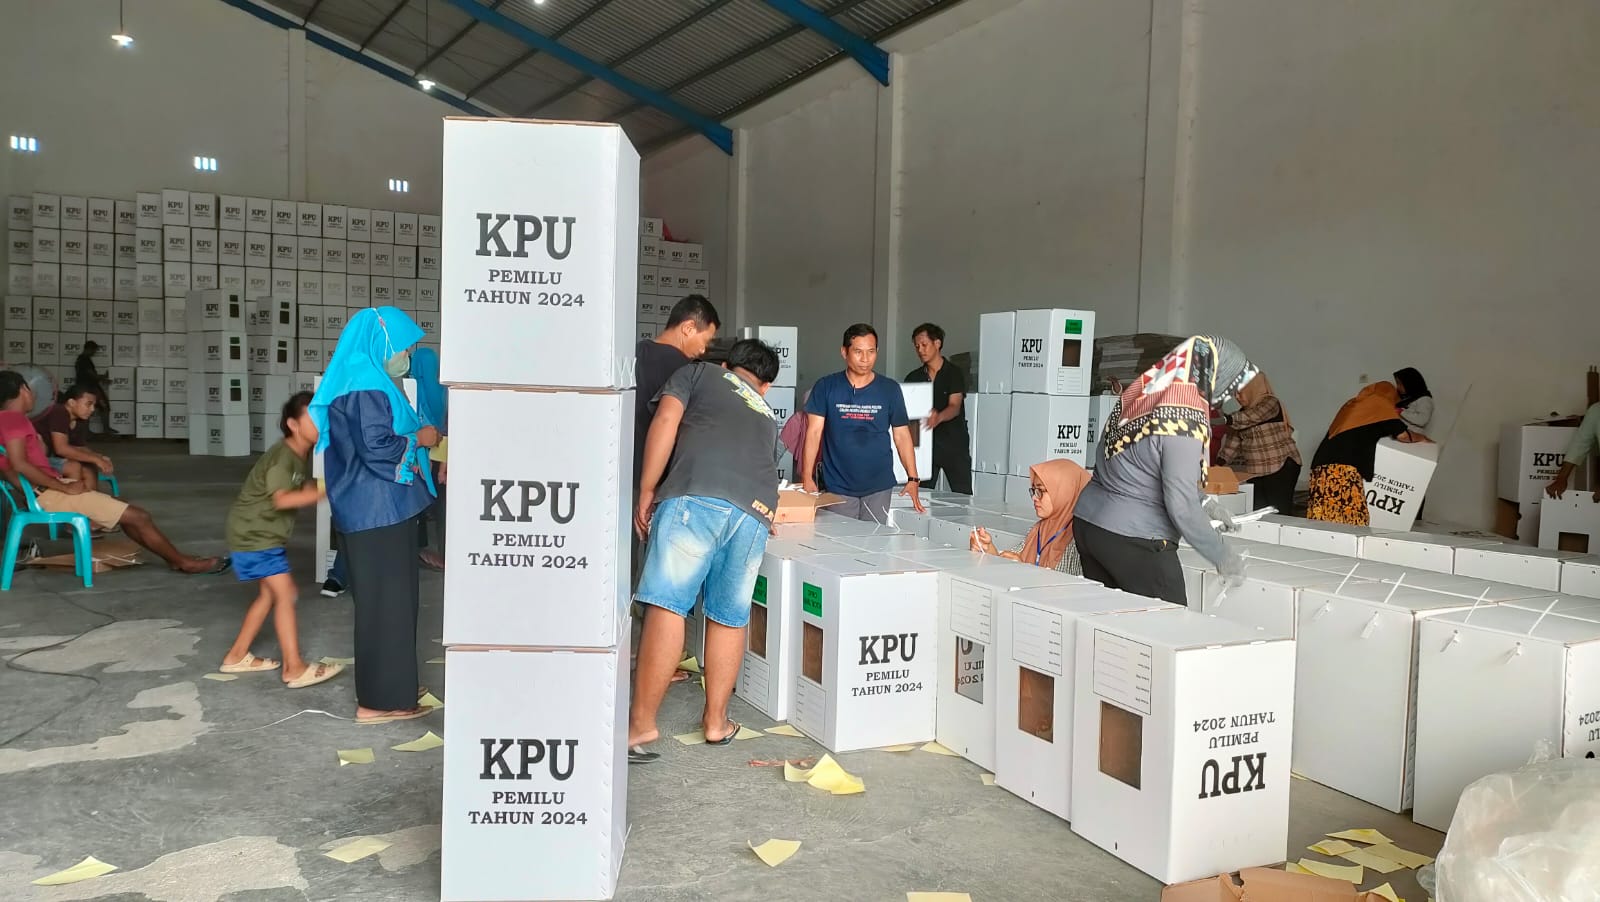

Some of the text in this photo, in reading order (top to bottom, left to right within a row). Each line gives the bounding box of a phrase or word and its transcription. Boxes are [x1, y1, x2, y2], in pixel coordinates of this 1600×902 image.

[476, 213, 576, 260] KPU
[488, 269, 562, 284] PEMILU
[464, 289, 584, 307] TAHUN 2024
[1021, 339, 1042, 353] KPU
[1057, 425, 1081, 439] KPU
[1533, 453, 1566, 467] KPU
[1374, 482, 1403, 495] PEMILU
[1389, 479, 1414, 491] TAHUN
[480, 479, 579, 524] KPU
[1366, 490, 1405, 515] KPU
[492, 533, 566, 548] PEMILU
[468, 553, 588, 569] TAHUN 2024
[858, 633, 918, 665] KPU
[866, 669, 909, 681] PEMILU
[852, 682, 923, 696] TAHUN 2024
[1193, 712, 1275, 732] TAHUN 2024
[1209, 732, 1259, 749] PEMILU
[480, 739, 578, 780] KPU
[1199, 752, 1266, 799] KPU
[492, 792, 565, 804] PEMILU
[468, 812, 587, 824] TAHUN 2024
